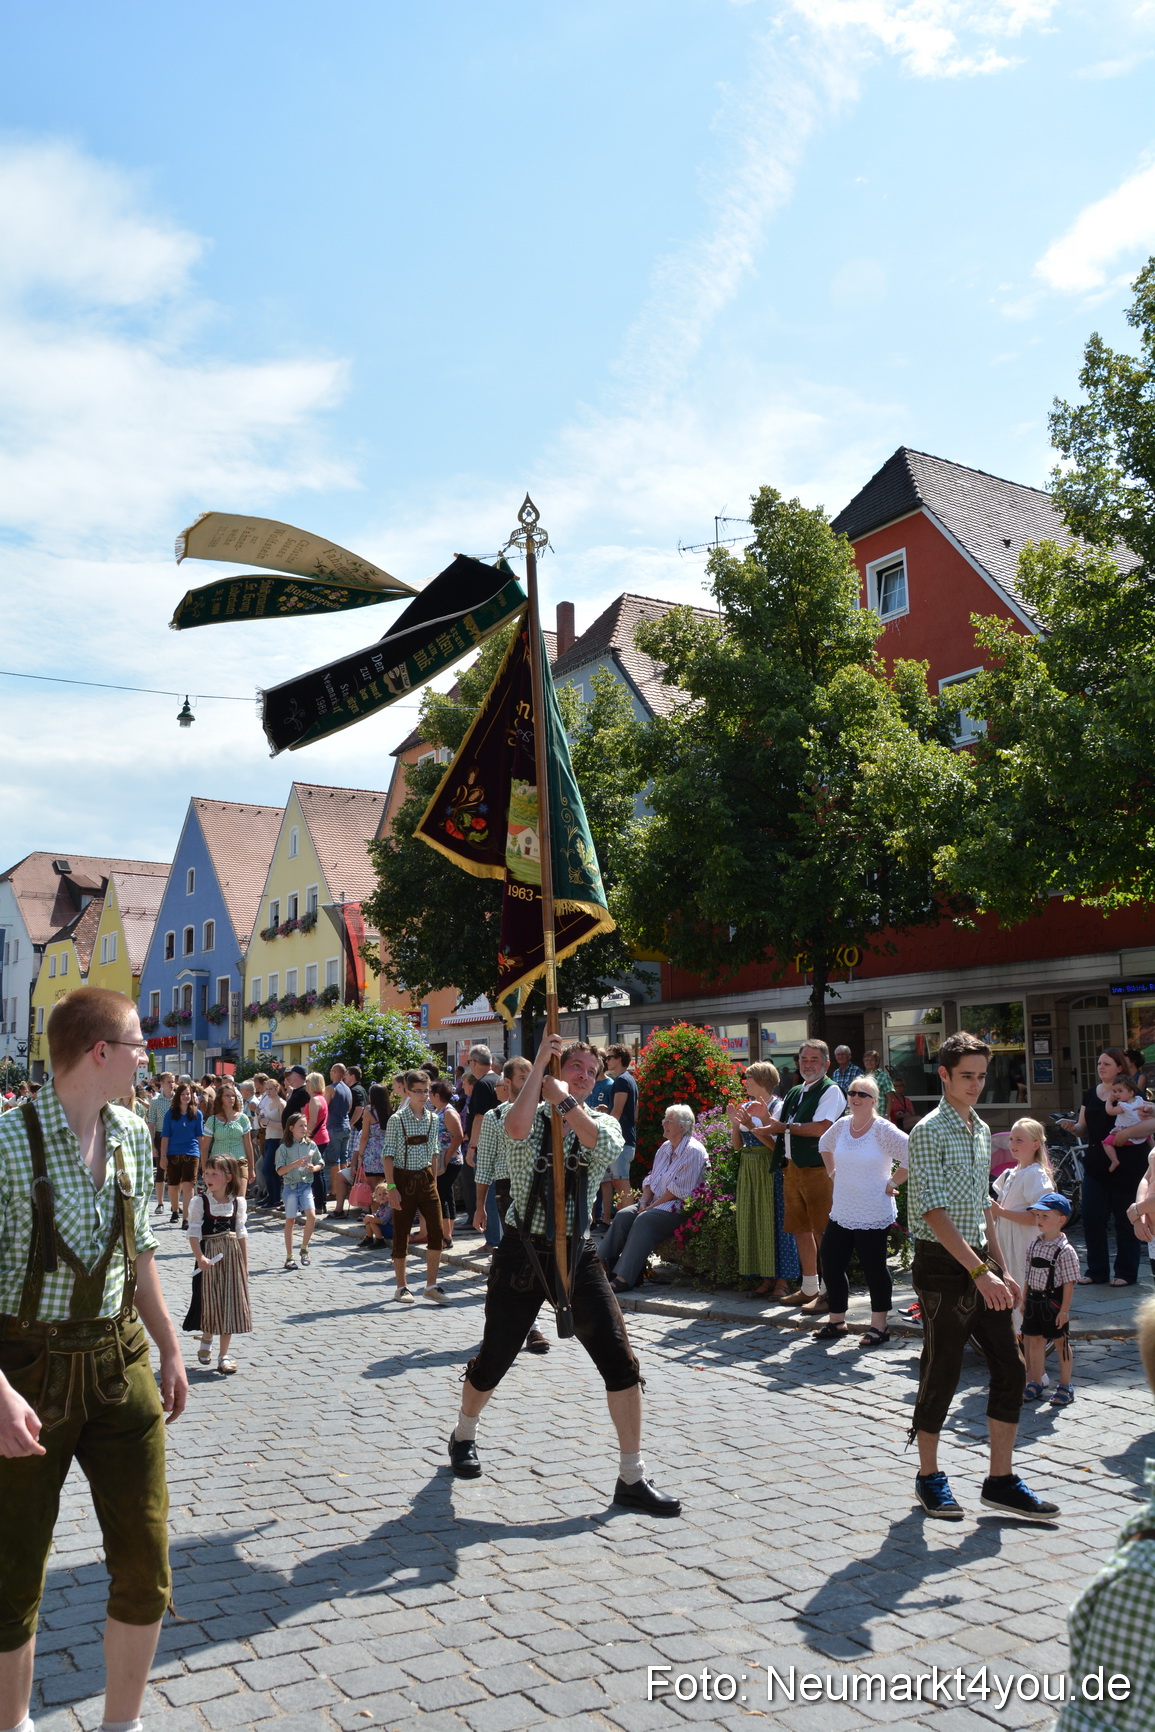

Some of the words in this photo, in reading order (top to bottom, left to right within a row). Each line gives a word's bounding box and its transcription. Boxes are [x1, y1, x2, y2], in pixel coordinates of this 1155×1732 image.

[360, 666, 372, 681] zur
[322, 673, 341, 706] Neumark
[597, 1092, 604, 1101] 2
